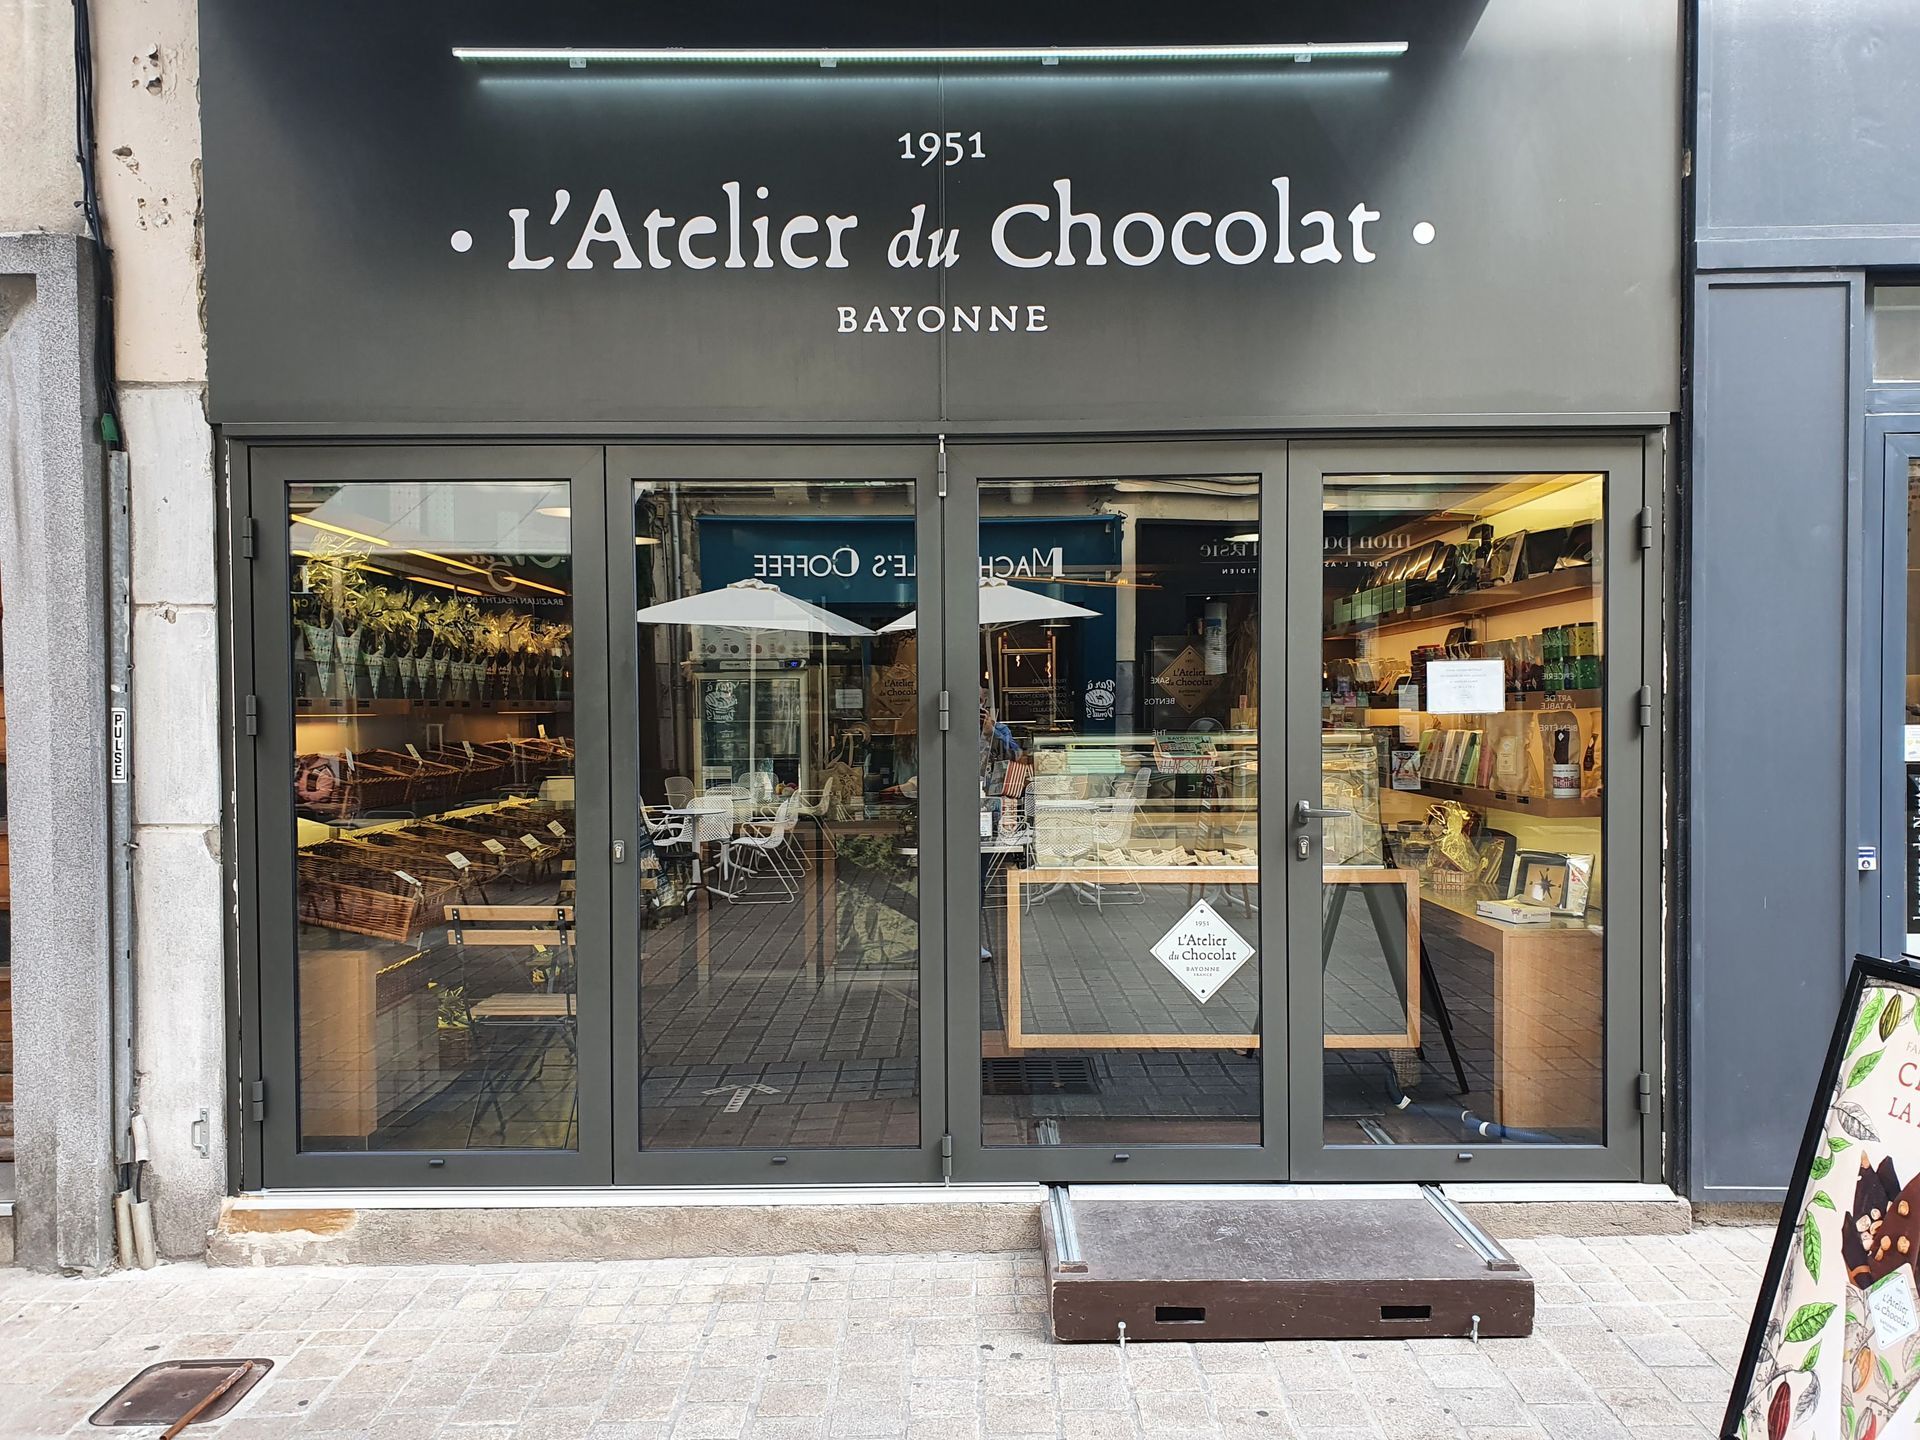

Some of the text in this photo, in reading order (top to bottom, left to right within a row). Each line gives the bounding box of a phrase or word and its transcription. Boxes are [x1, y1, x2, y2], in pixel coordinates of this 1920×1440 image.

[898, 131, 986, 167] 1951
[507, 176, 1382, 271] L'Atelier du Chocolat
[837, 305, 1049, 333] BAYONNE
[114, 714, 122, 776] PULSE
[1168, 947, 1237, 961] du Chocolat
[1177, 933, 1228, 947] L'Atelier
[1888, 1096, 1912, 1125] LA
